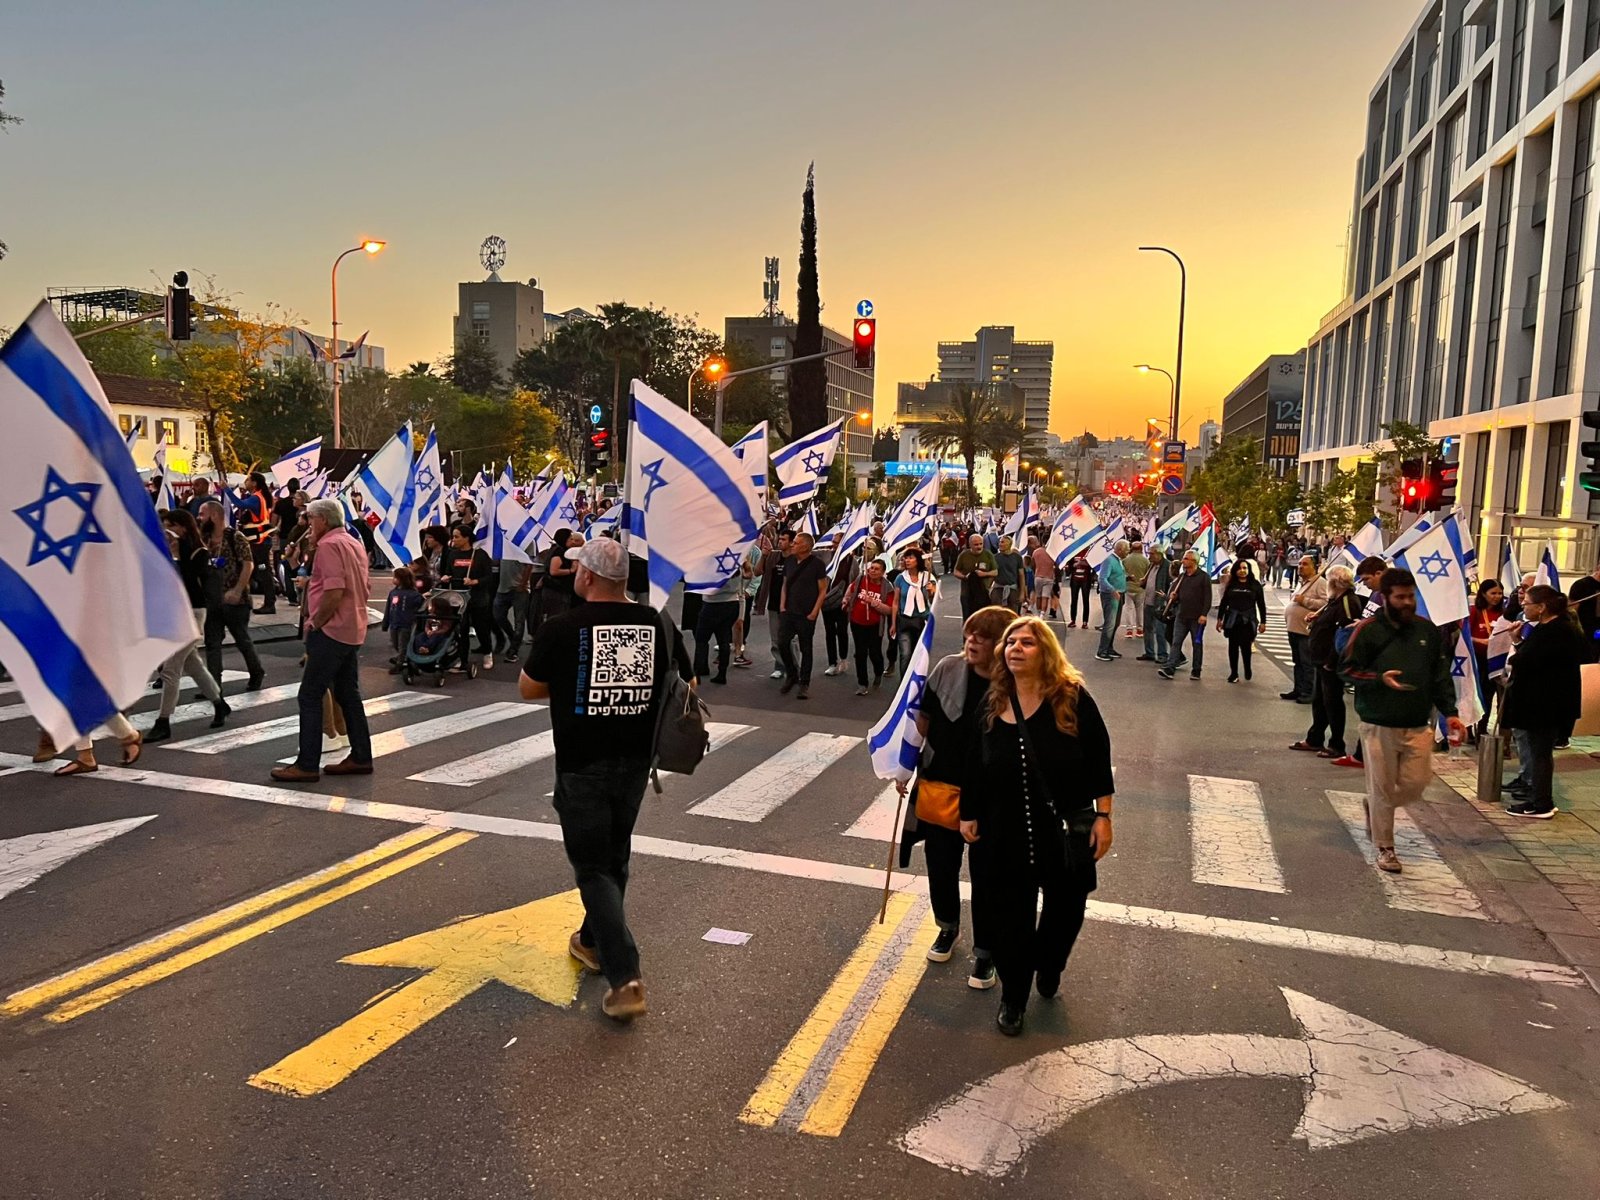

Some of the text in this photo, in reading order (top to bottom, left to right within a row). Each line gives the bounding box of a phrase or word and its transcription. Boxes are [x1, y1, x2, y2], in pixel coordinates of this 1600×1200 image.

[1270, 435, 1298, 456] שנה
[575, 627, 588, 704] הדגלים השחורים
[588, 688, 653, 706] סורקים
